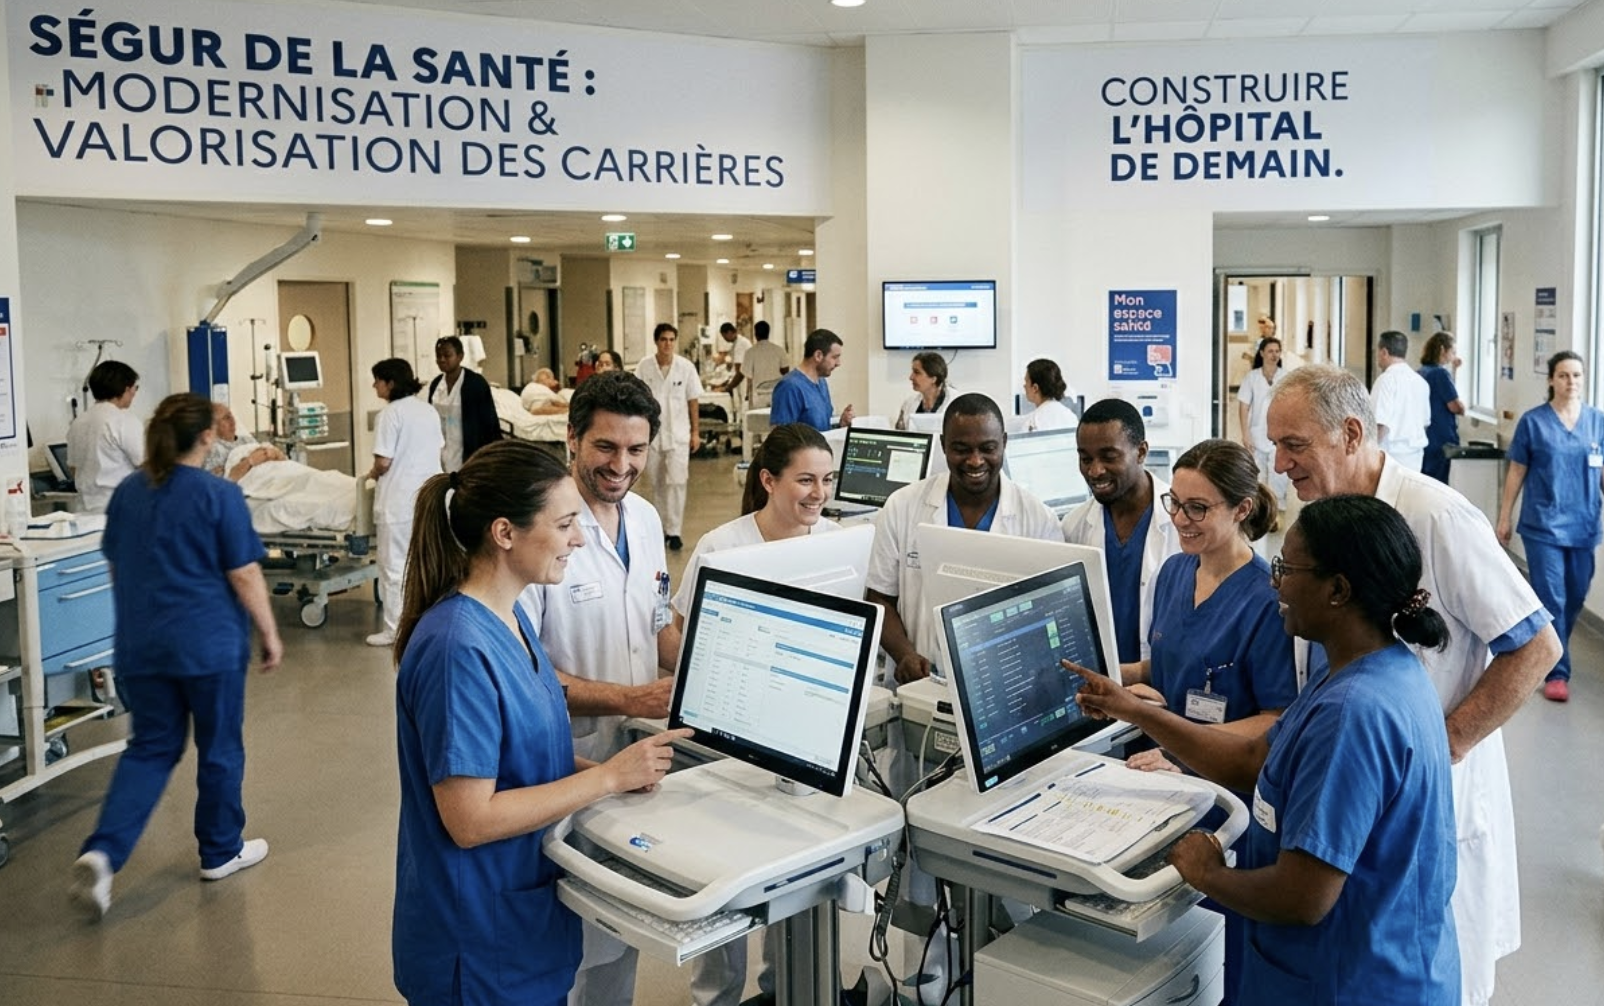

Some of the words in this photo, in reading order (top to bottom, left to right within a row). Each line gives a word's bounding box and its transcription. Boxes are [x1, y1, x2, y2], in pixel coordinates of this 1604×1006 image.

[29, 8, 227, 69] SÉGUR
[244, 33, 314, 75] DE
[332, 41, 398, 81] LA
[412, 47, 571, 94] SANTÉ
[62, 68, 511, 133] MODERNISATION
[527, 100, 559, 136] &
[1100, 71, 1349, 107] CONSTRUIRE
[1112, 104, 1323, 145] L'HÔPITAL
[32, 117, 441, 175] VALORISATION
[461, 141, 546, 179] DES
[561, 144, 784, 188] CARRIÈRES
[1110, 153, 1159, 182] DE
[1173, 148, 1344, 181] DEMAIN.
[1114, 294, 1144, 306] Mon
